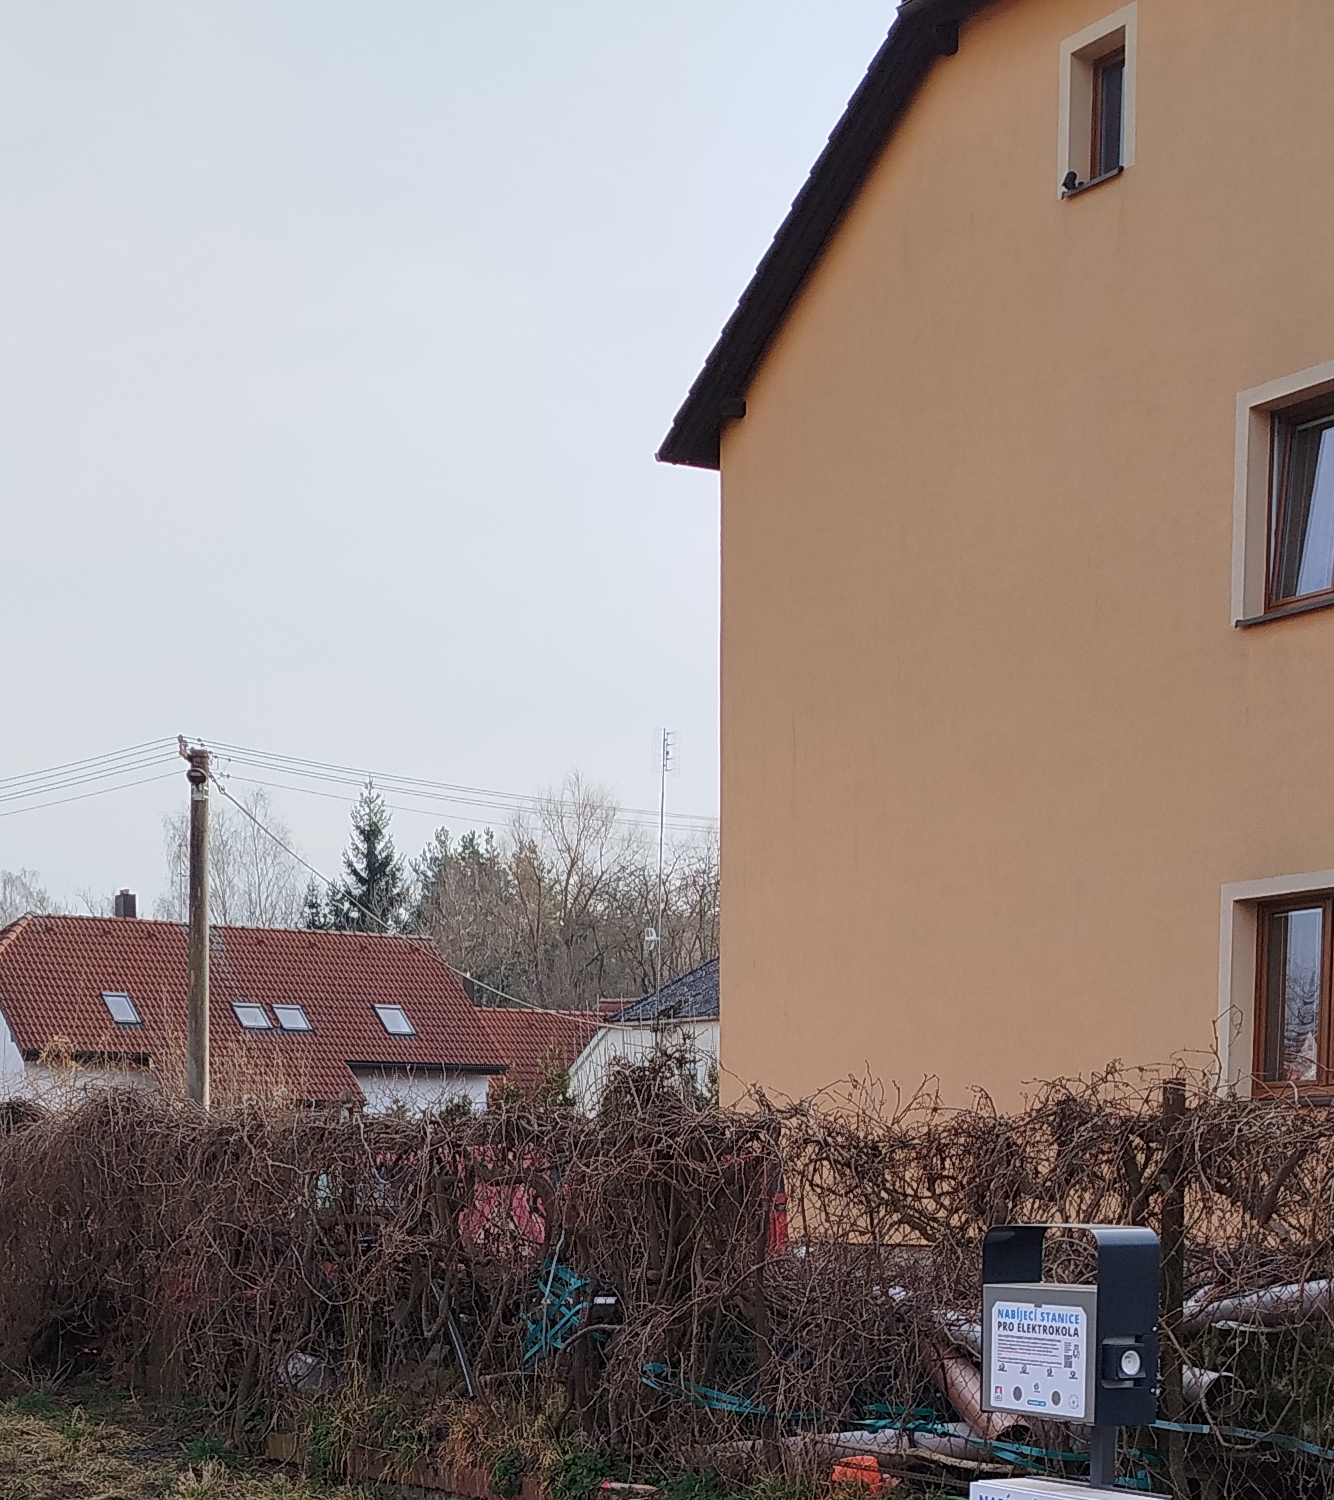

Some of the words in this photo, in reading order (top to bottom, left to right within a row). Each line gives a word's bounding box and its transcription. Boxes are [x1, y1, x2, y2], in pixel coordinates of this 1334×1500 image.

[997, 1307, 1037, 1323] NABÍJECÍ
[1039, 1311, 1080, 1325] STANICE
[997, 1321, 1015, 1332] PRO
[1017, 1322, 1080, 1338] ELEKTROKOLA
